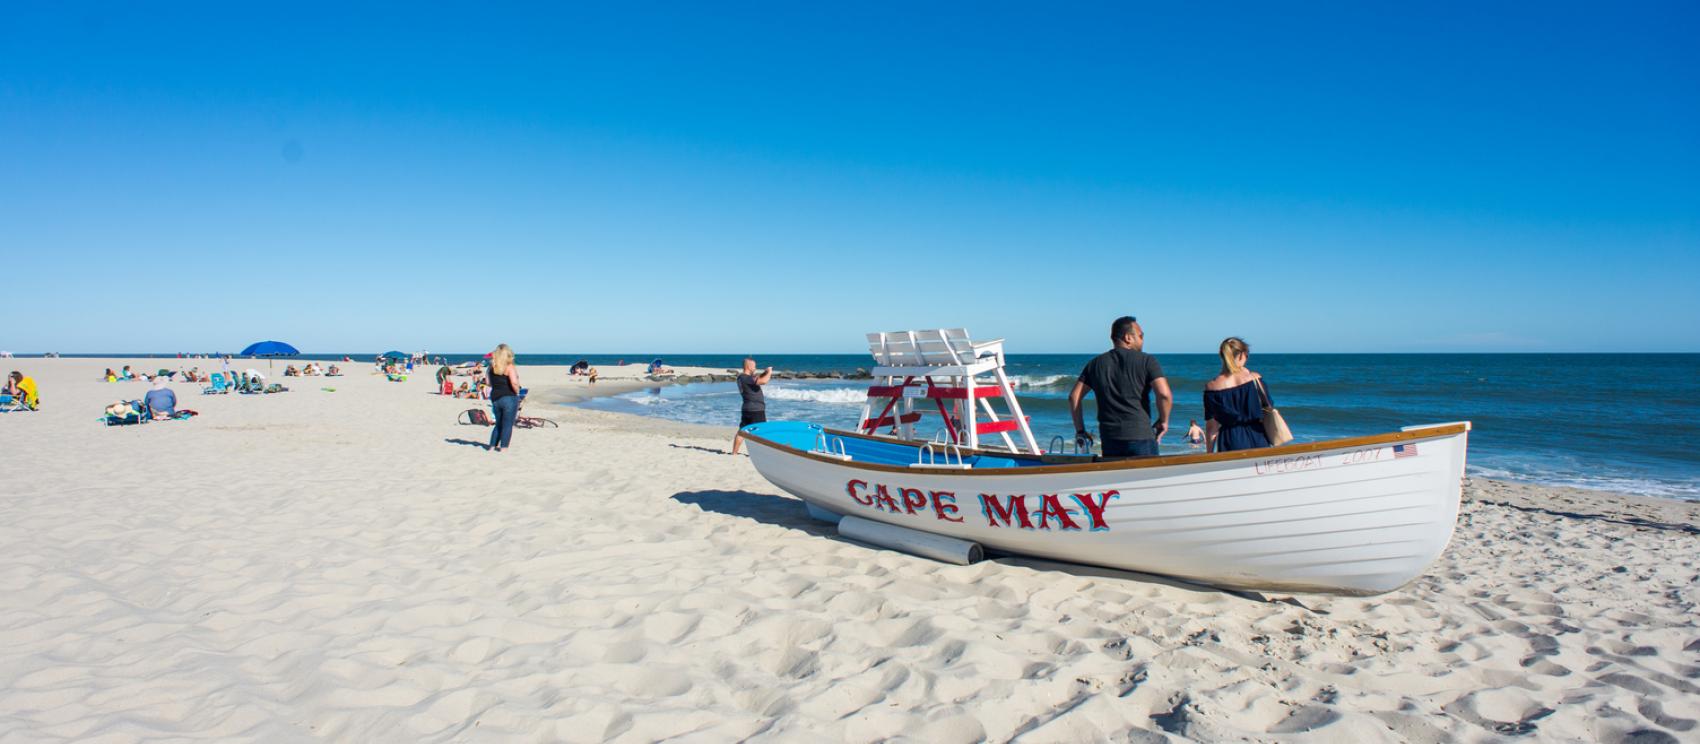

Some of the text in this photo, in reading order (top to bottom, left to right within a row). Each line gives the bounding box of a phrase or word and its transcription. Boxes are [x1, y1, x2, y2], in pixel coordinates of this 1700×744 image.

[1254, 453, 1322, 475] LIFEBOAT
[846, 479, 1120, 532] CAPE MAY
